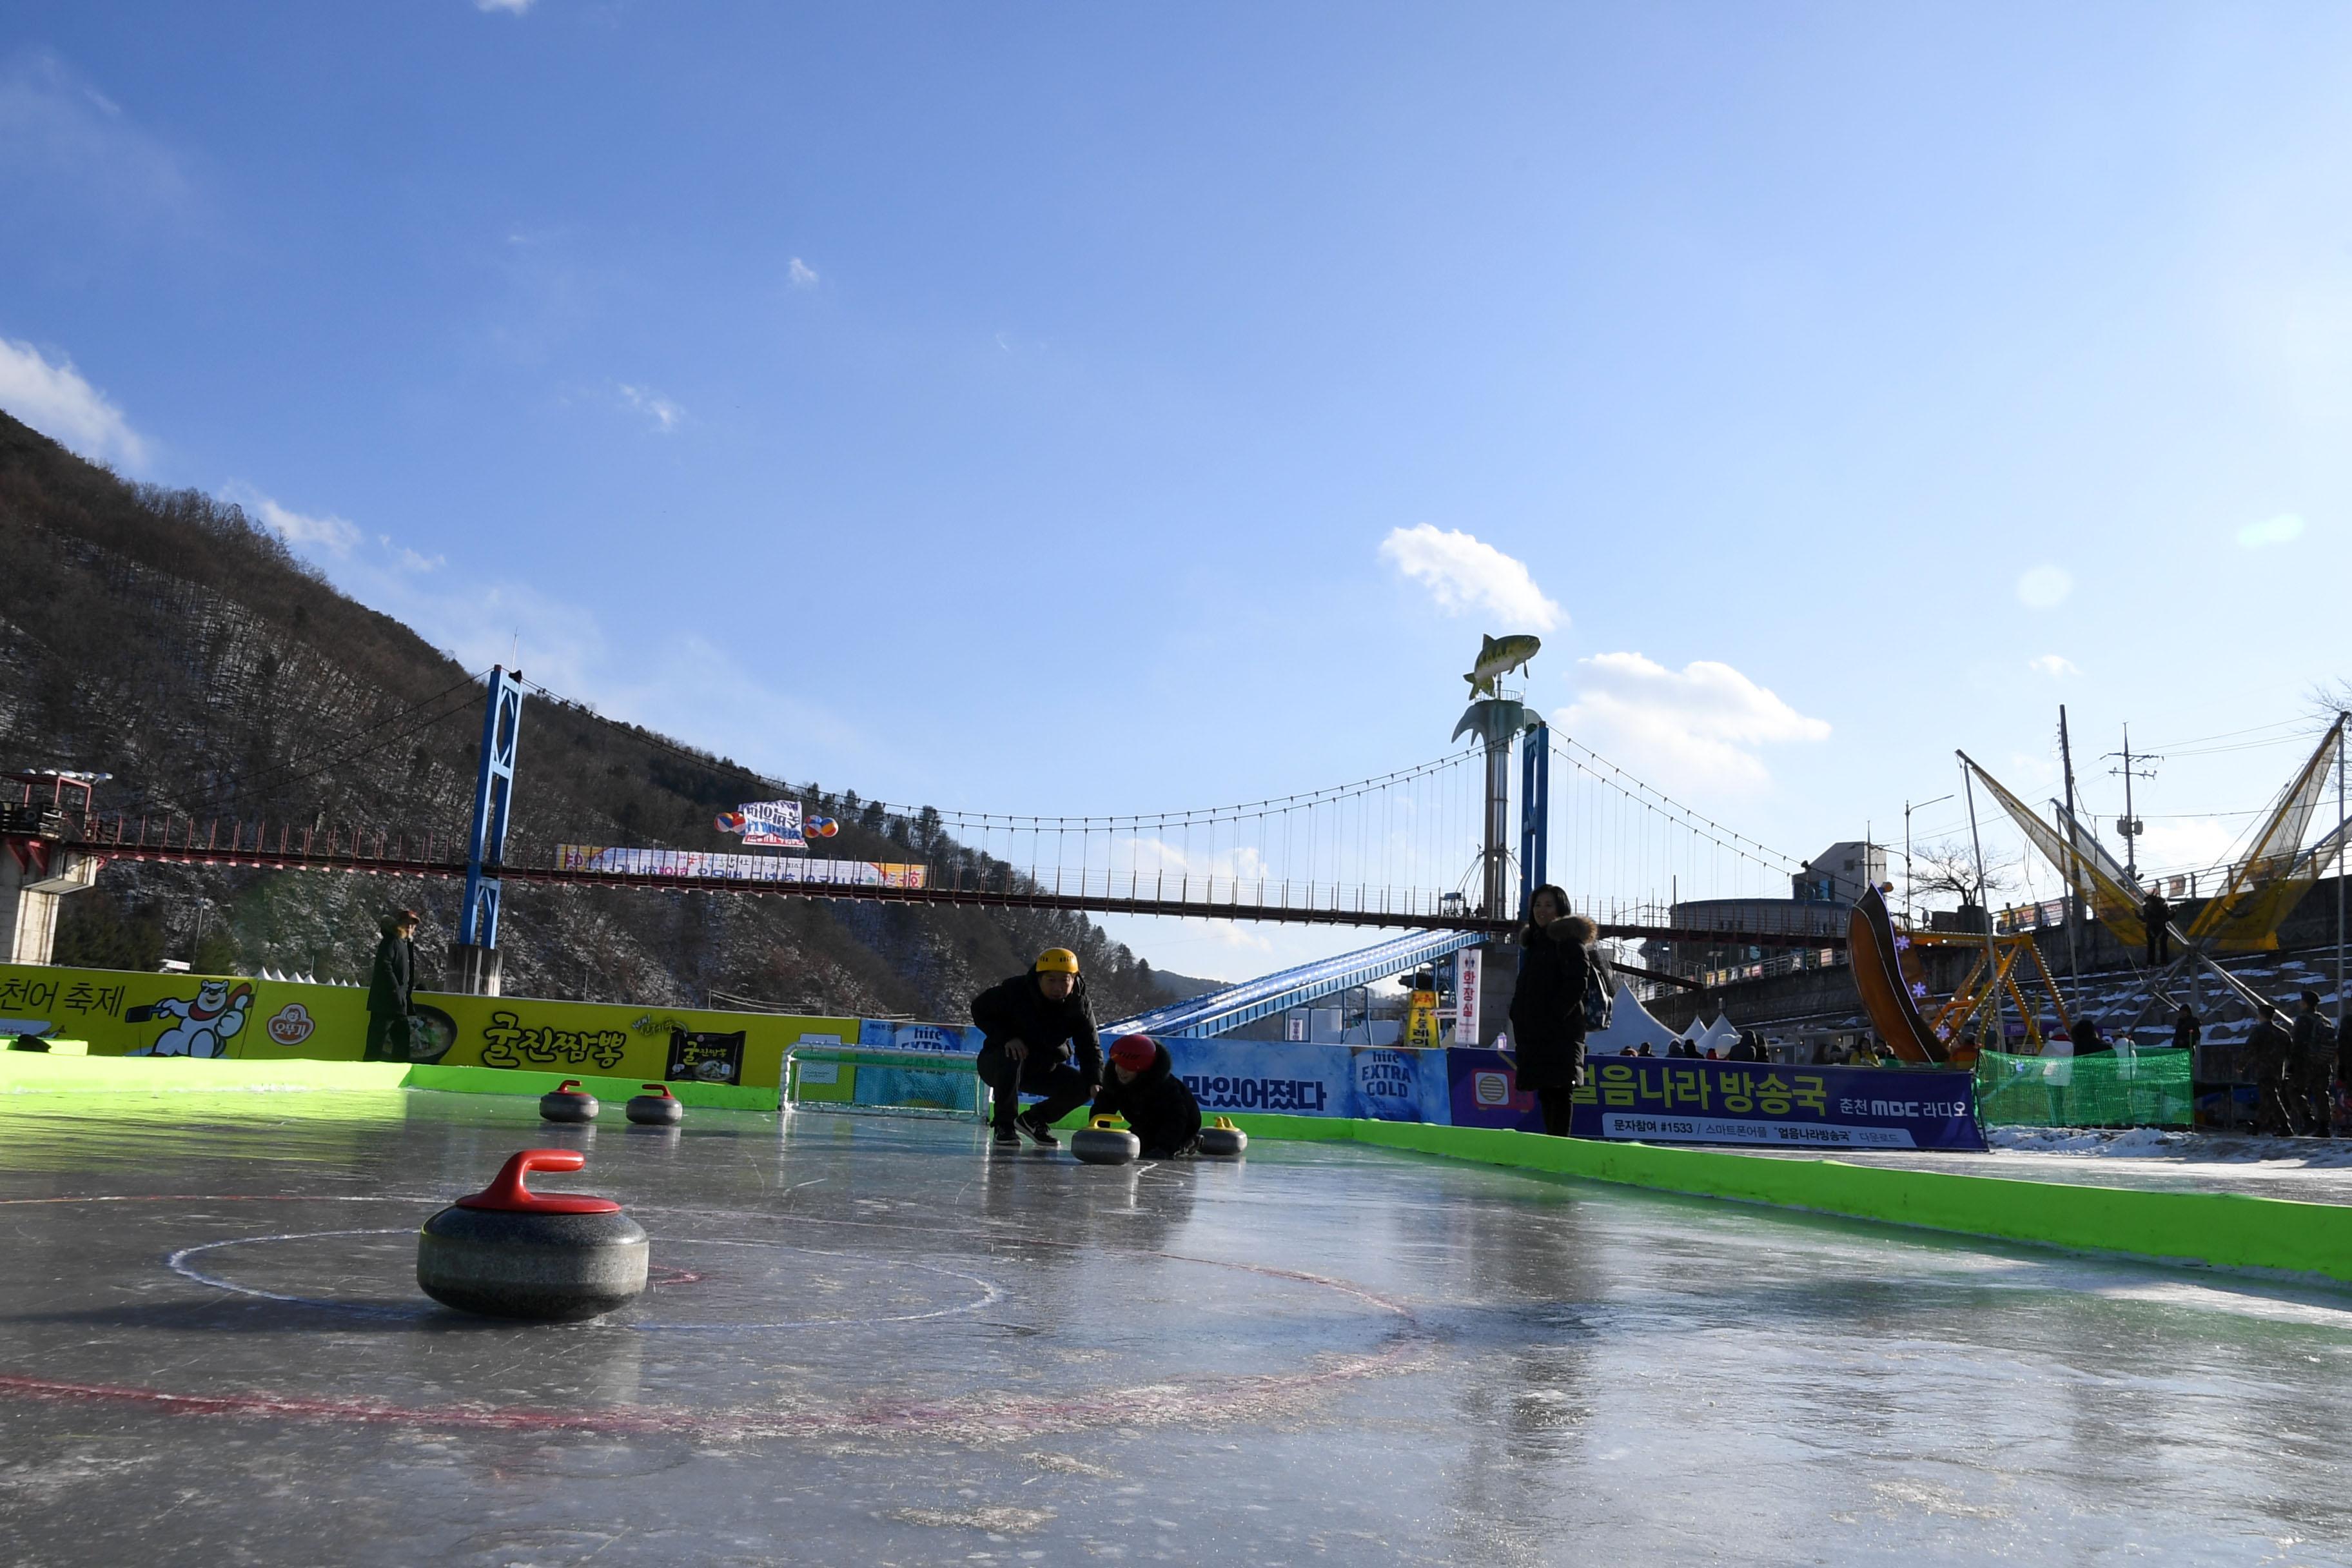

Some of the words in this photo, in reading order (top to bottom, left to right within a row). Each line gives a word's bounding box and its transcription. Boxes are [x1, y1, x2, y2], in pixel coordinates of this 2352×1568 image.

[0, 978, 60, 1014] 천어
[64, 982, 126, 1018] 축제
[1463, 971, 1475, 1017] 화장실
[275, 1023, 306, 1037] 오뚜기
[483, 1011, 627, 1069] 굴진짬뽕
[914, 1026, 943, 1041] hite
[1373, 1051, 1400, 1064] hite
[1362, 1064, 1412, 1084] EXTRA
[1182, 1075, 1328, 1112] 맛있어졌다
[1366, 1081, 1408, 1098] COLD
[1719, 1071, 1827, 1117] 방송국
[1840, 1098, 1868, 1116] 춘천
[1923, 1101, 1968, 1118] 라디오
[1614, 1119, 1657, 1133] 문자참여
[1660, 1122, 1693, 1133] #1533
[1705, 1124, 1767, 1139] 스마트폰어플
[1859, 1132, 1901, 1142] 다운로드
